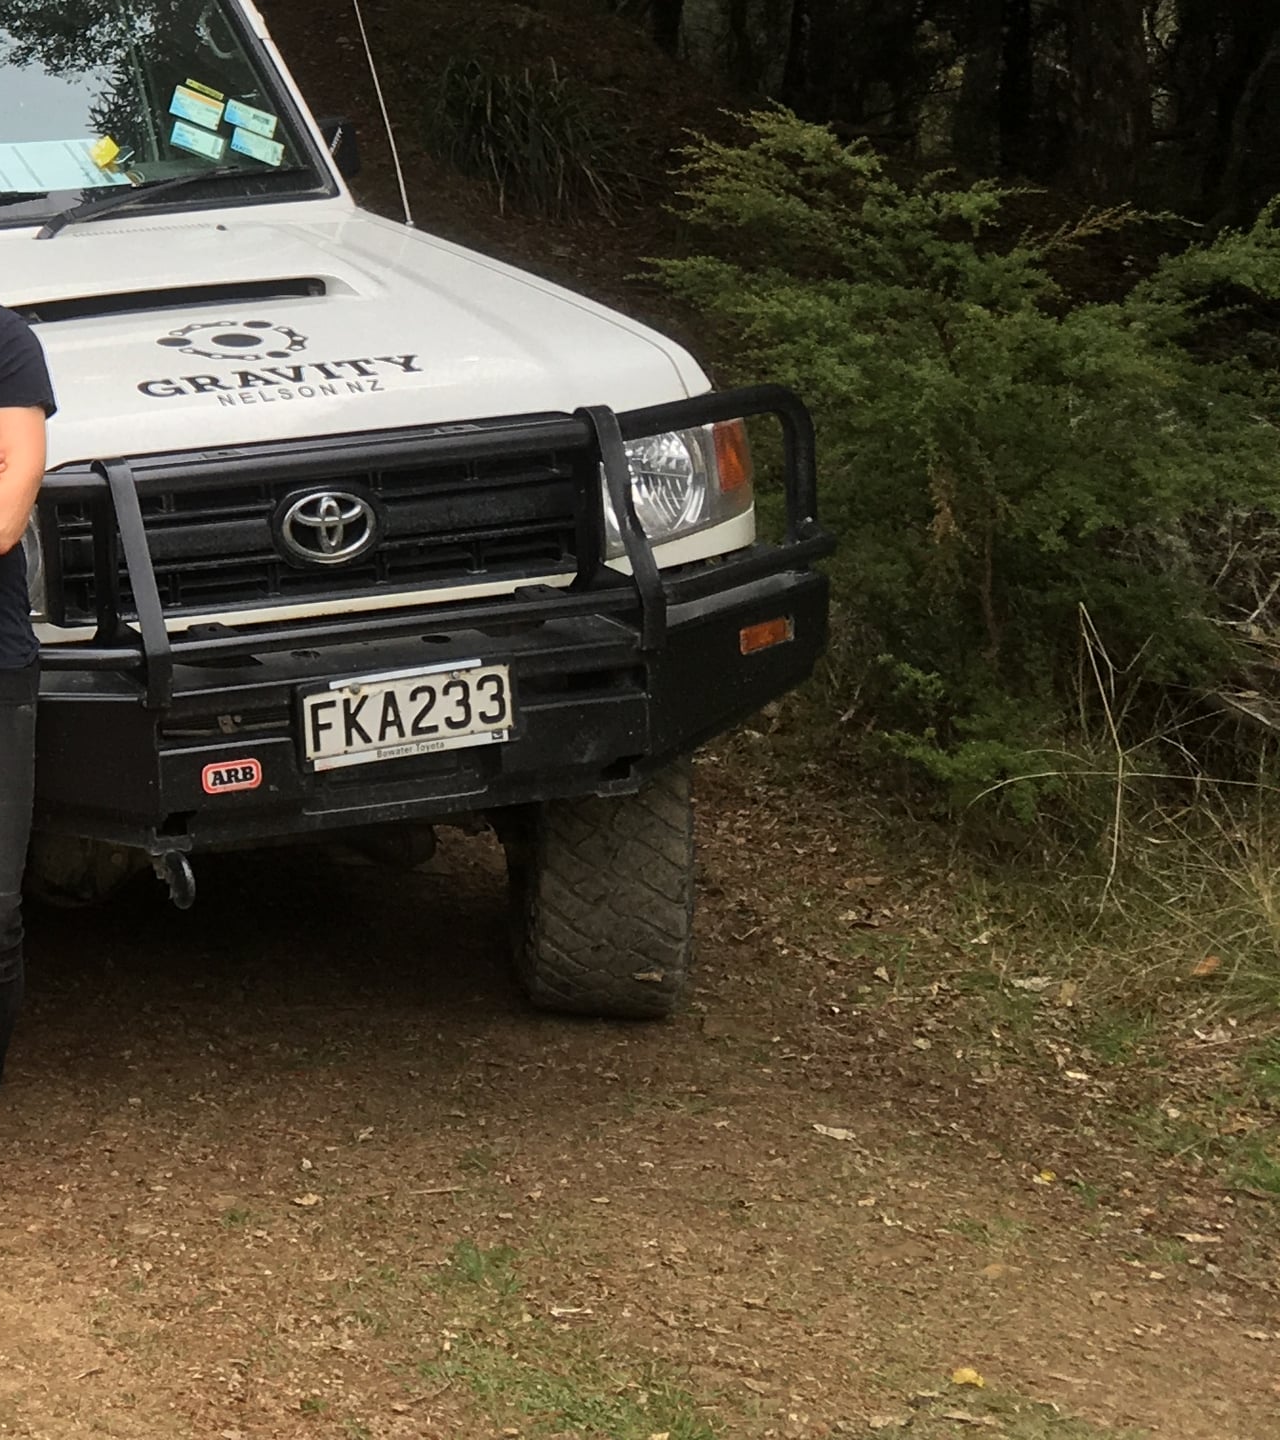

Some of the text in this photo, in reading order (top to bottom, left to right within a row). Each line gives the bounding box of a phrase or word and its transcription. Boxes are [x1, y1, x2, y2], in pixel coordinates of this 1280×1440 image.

[136, 354, 424, 398] GRAVITY
[217, 379, 386, 407] NELSON NZ
[310, 673, 506, 753] FKA233
[415, 741, 445, 753] Toyota
[211, 765, 255, 787] ARB
